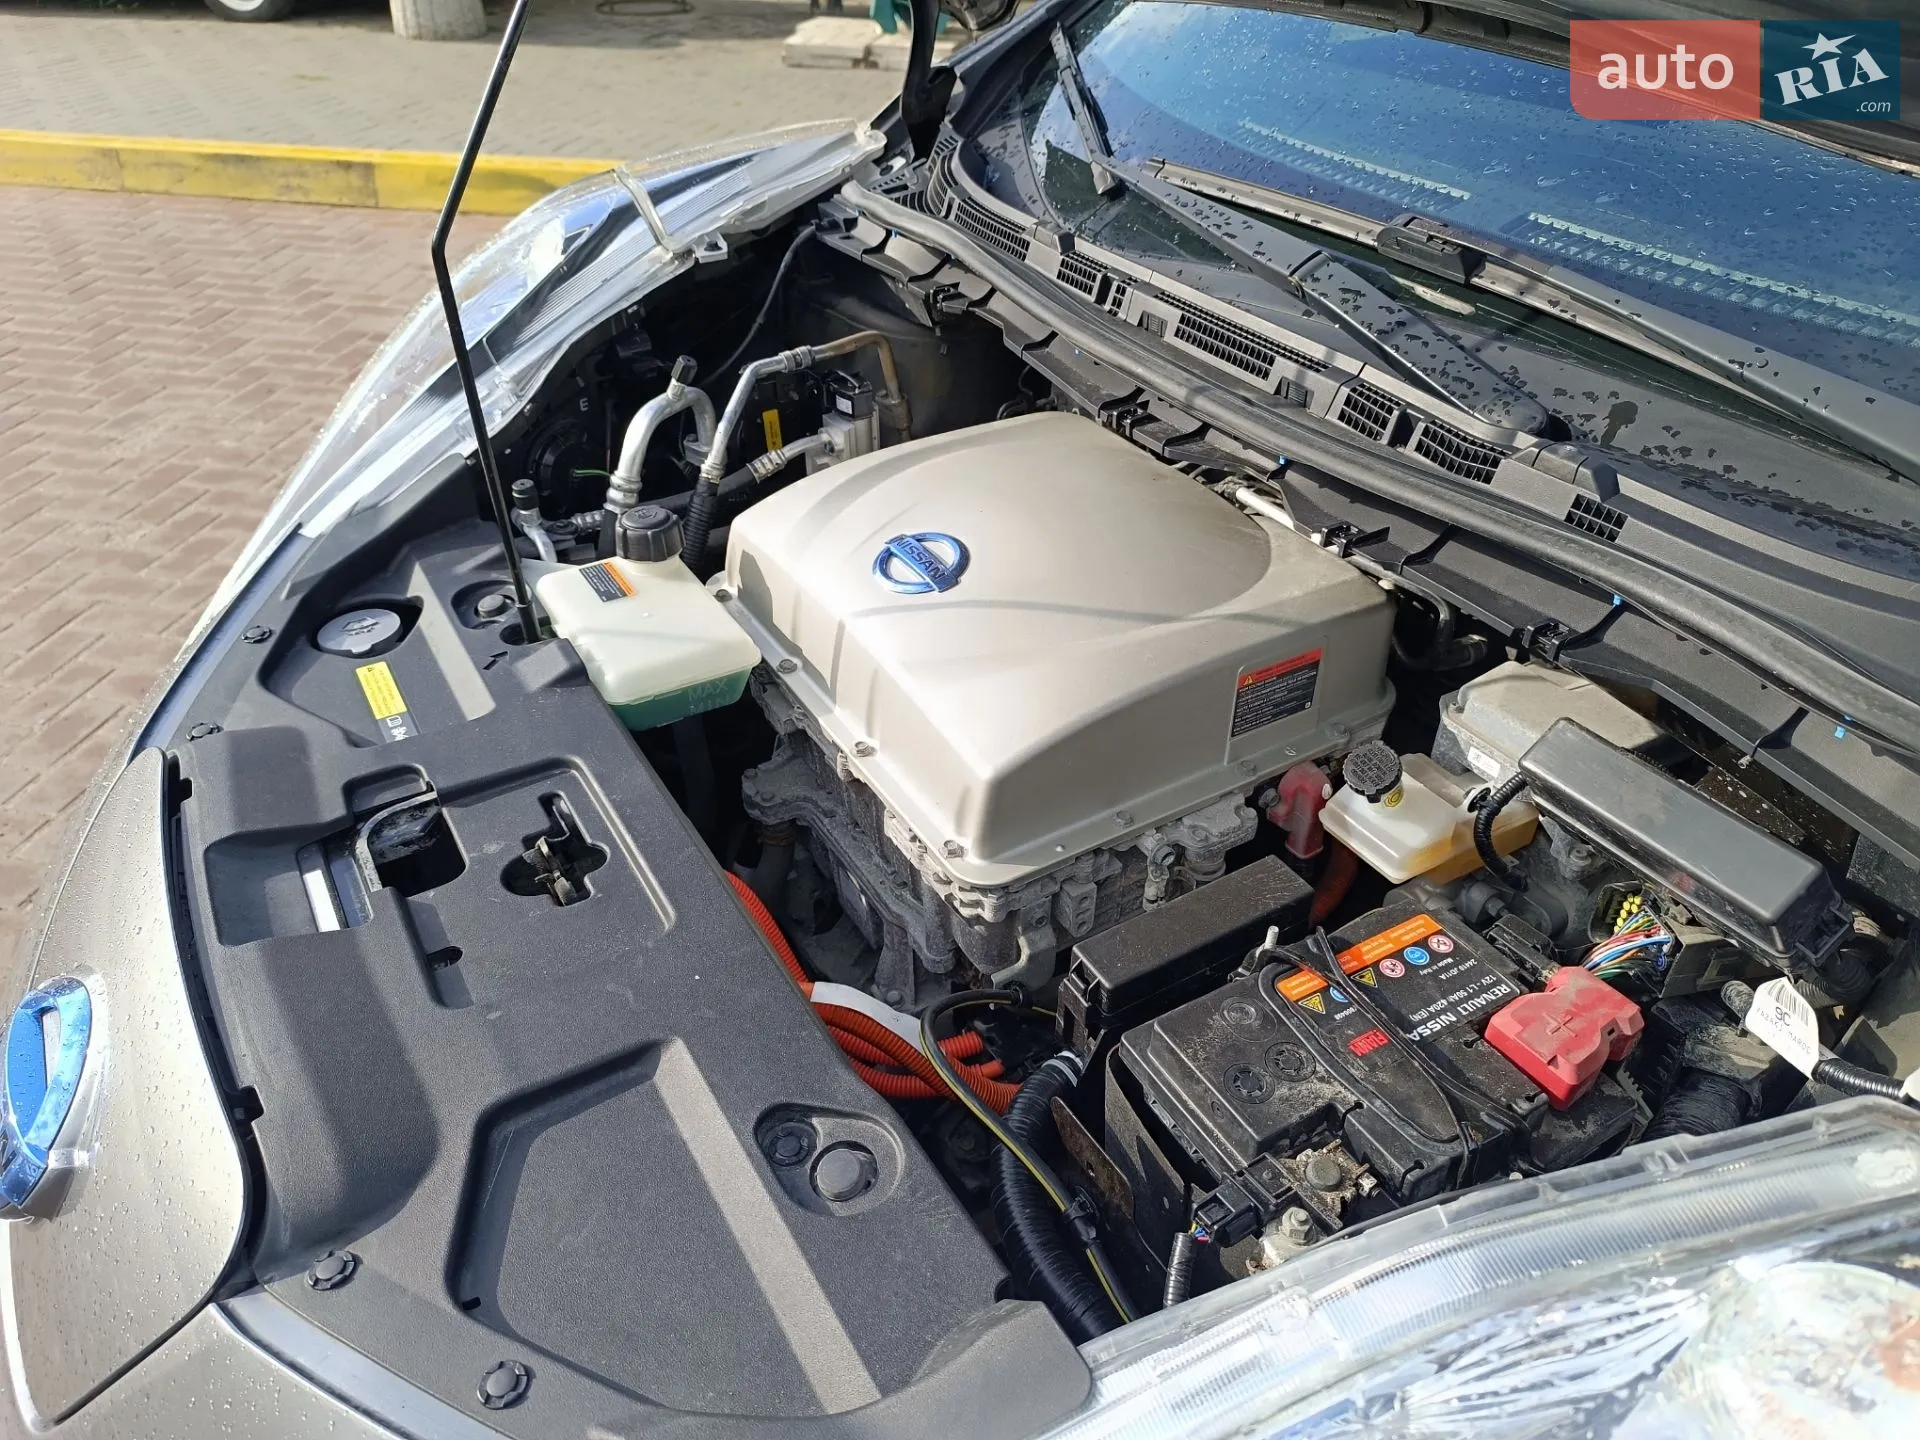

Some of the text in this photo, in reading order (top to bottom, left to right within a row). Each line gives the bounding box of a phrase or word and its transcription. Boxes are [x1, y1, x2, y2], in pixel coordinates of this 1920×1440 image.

[893, 539, 946, 581] NISSAN
[688, 678, 728, 701] MAX
[1466, 984, 1479, 993] L1
[1481, 974, 1497, 986] 12V
[1426, 999, 1448, 1013] 420A
[1456, 983, 1512, 1016] RENAULT
[1408, 1008, 1430, 1022] (EN)
[1775, 1006, 1791, 1027] 9C
[1405, 1012, 1458, 1041] NISSA
[1349, 1031, 1389, 1057] FIAMM
